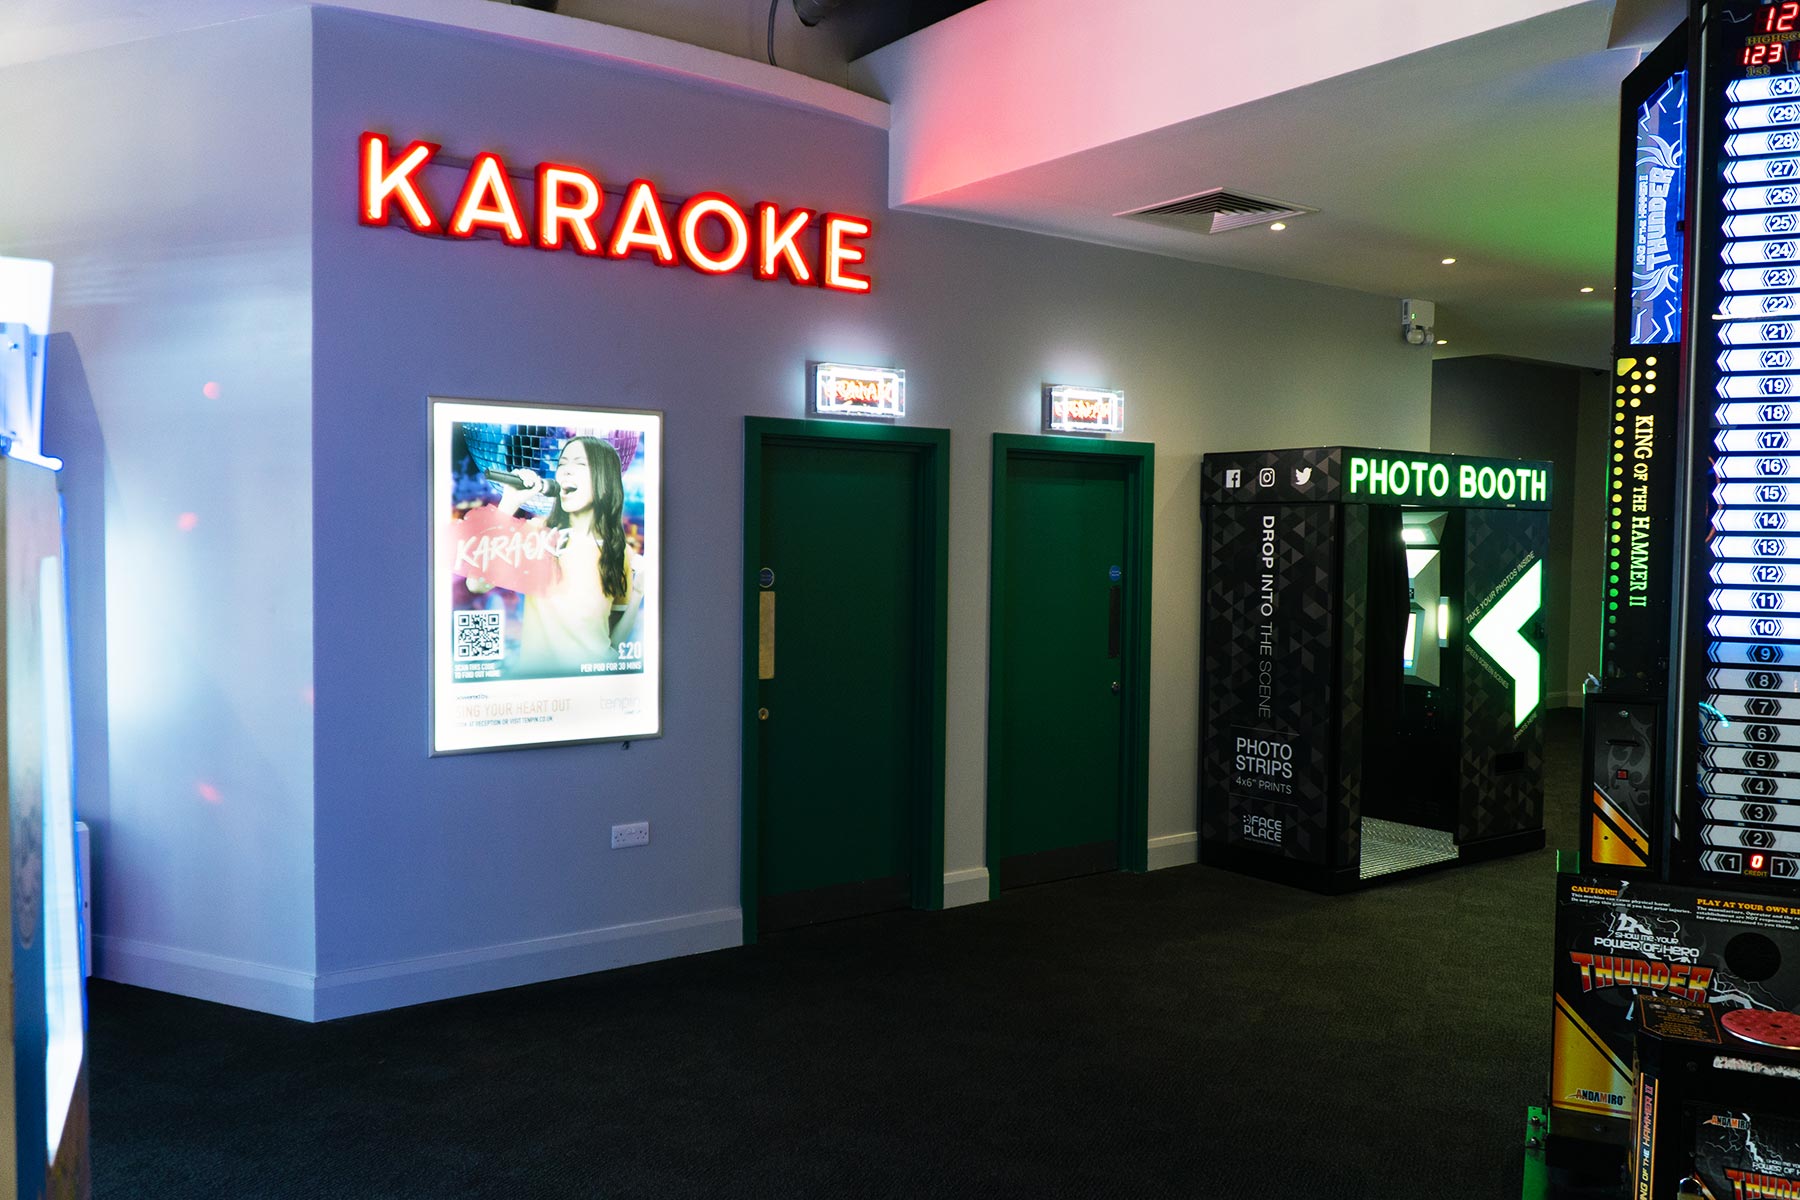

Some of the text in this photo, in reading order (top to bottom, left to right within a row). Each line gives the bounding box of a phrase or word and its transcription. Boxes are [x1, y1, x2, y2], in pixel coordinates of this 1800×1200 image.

[1746, 33, 1800, 45] HIGHSC
[1744, 43, 1782, 65] 123
[1747, 65, 1770, 77] 1st
[1775, 80, 1795, 94] 30
[1774, 107, 1794, 121] 29
[1774, 134, 1793, 148] 28
[1773, 162, 1793, 176] 27
[1772, 189, 1792, 203] 26
[358, 131, 872, 294] KARAOKE
[1646, 167, 1675, 271] THUNDER
[1772, 217, 1790, 230] 25
[1771, 244, 1790, 257] 24
[1770, 271, 1789, 285] 23
[1769, 298, 1788, 311] 22
[1769, 326, 1786, 338] 21
[1767, 352, 1786, 366] 20
[1766, 379, 1785, 393] 19
[1765, 406, 1784, 420] 18
[1764, 434, 1782, 447] 17
[1763, 460, 1780, 473] 16
[1351, 457, 1546, 502] PHOTO BOOTH
[1762, 487, 1780, 500] 15
[1629, 415, 1654, 607] KING OF THE HAMMER II
[1762, 514, 1778, 527] 14
[454, 527, 574, 572] KARAOKE
[1760, 540, 1778, 553] 13
[1759, 567, 1777, 580] 12
[1466, 550, 1535, 624] TAKE YOUR PHOTOS INSIDE
[1759, 594, 1775, 607] 11
[1259, 516, 1275, 718] DROP INTO THE SCENE
[1757, 621, 1775, 634] 10
[618, 641, 641, 660] £20
[1761, 648, 1770, 660] 9
[581, 664, 592, 672] PER
[606, 662, 617, 671] FOR
[619, 661, 626, 670] 30
[626, 661, 641, 670] MINS
[1760, 675, 1768, 687] 8
[485, 702, 512, 717] YOUR
[517, 699, 548, 715] HEART
[552, 698, 572, 713] OUT
[1759, 701, 1768, 713] 7
[1758, 728, 1767, 740] 6
[1237, 737, 1293, 761] PHOTO
[1236, 755, 1293, 779] STRIPS
[1757, 755, 1765, 767] 5
[1259, 780, 1292, 795] PRINTS
[1755, 781, 1764, 793] 4
[1755, 807, 1763, 818] 3
[1251, 815, 1282, 831] FACE
[1244, 825, 1282, 842] PLACE
[1754, 833, 1762, 845] 2
[1729, 857, 1735, 869] 1
[1752, 855, 1763, 868] 0
[1778, 862, 1783, 873] 1
[1744, 869, 1768, 877] CREDIT
[1571, 886, 1618, 896] CAUTION!!!
[1697, 898, 1721, 907] PLAY
[1738, 903, 1764, 911] YOUR
[1615, 932, 1639, 940] SHOW
[1656, 936, 1679, 945] YOUR
[1594, 937, 1700, 958] POWER OF HERO
[1570, 951, 1714, 1003] THUNDER
[1645, 1084, 1653, 1095] II
[1576, 1088, 1624, 1106] ANDAMIRO
[1643, 1095, 1653, 1147] HAMMER
[1752, 1162, 1782, 1172] POWER
[1642, 1168, 1649, 1181] OF
